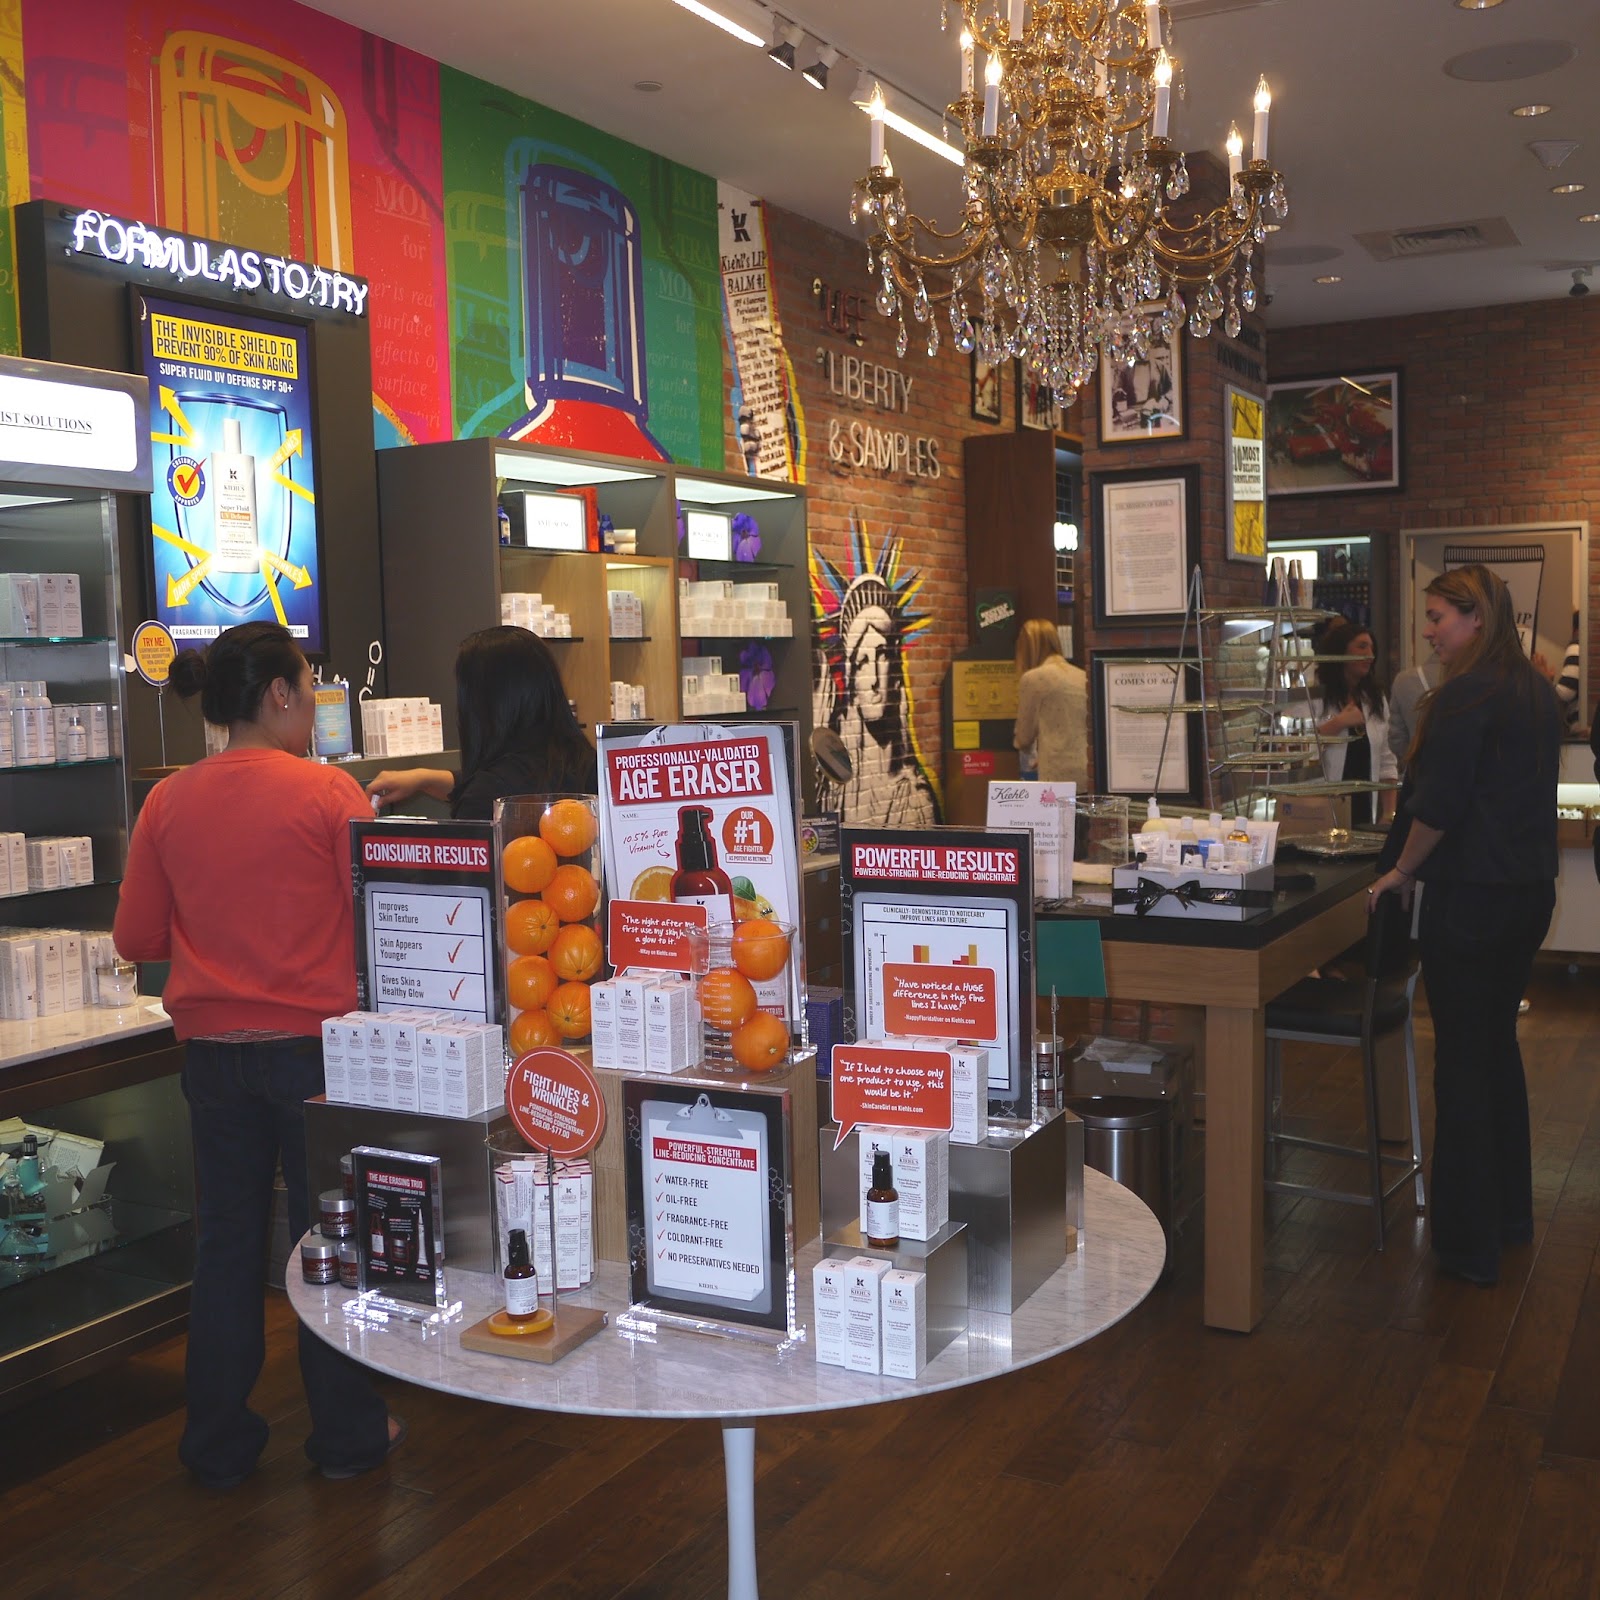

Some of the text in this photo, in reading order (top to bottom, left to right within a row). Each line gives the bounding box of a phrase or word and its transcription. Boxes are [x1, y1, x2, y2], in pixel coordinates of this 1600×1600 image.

[73, 210, 368, 315] FORMULAS TO TRY
[722, 251, 767, 271] Kiehl's LIP
[728, 274, 766, 294] BALM #1
[156, 320, 292, 357] THE INVISIBLE SHIELD TO
[157, 338, 294, 373] PREVENT 90% OF SKIN AGING
[160, 363, 293, 393] SUPER FLUID UV DEFENSE SPF 50+
[830, 351, 913, 413] LIBERTY
[24, 414, 92, 431] SOLUTIONS
[830, 419, 941, 479] & SAMPLES
[1242, 447, 1260, 462] MOST
[173, 583, 191, 602] DARK
[143, 637, 165, 647] TRY ME!
[1115, 678, 1145, 686] COMES
[616, 745, 759, 769] PROFESSIONALLY-VALIDATED
[619, 759, 762, 800] AGE ERASER
[991, 787, 1029, 800] Kiehl's
[741, 811, 753, 819] OUR
[734, 821, 760, 844] #1
[656, 839, 664, 847] C
[365, 843, 487, 866] CONSUMER RESULTS
[855, 847, 1016, 873] POWERFUL RESULTS
[855, 868, 1016, 882] POWERFUL-STRENGTH LINE-REDUCING CONCENTRATE
[379, 901, 409, 913] Improves
[912, 908, 948, 916] DEMONSTRATED
[957, 910, 985, 918] NOTICEABLY
[379, 913, 419, 924] Skin Texture
[641, 917, 659, 927] night
[661, 919, 683, 927] after
[622, 925, 639, 933] first
[654, 928, 663, 937] my
[380, 938, 423, 951] Skin Appears
[642, 936, 656, 945] glow
[380, 949, 407, 961] Younger
[382, 975, 399, 986] Gives
[401, 976, 414, 987] Skin
[921, 981, 952, 990] noticed
[963, 983, 984, 992] HUGE
[382, 986, 424, 999] Healthy Glow
[893, 990, 939, 999] difference
[950, 993, 966, 1001] the
[969, 994, 985, 1002] fine
[911, 1001, 928, 1009] lines
[857, 1063, 862, 1072] I
[864, 1064, 881, 1073] had
[884, 1066, 893, 1074] to
[896, 1067, 925, 1076] choose
[927, 1069, 944, 1080] only
[523, 1069, 589, 1107] FIGHT LINES &
[840, 1075, 944, 1089] one product to use, this
[532, 1085, 578, 1115] WRINKLES
[864, 1088, 887, 1097] would
[890, 1089, 901, 1098] be
[529, 1102, 576, 1126] POWERFUL-STRENGTH
[898, 1105, 923, 1113] Kiehls.com
[520, 1105, 584, 1136] LINE-REDUCING CONCENTRATE
[655, 1148, 755, 1169] LINE-REDUCING CONCENTRATE
[668, 1142, 741, 1159] POWERFUL-STRENGTH
[369, 1172, 422, 1189] THE AGE ERASING TRIO
[665, 1175, 709, 1189] WATER-FREE
[665, 1194, 698, 1207] OIL-FREE
[666, 1213, 729, 1231] FRAGRANCE-FREE
[667, 1232, 723, 1248] COLORANT-FREE
[668, 1252, 760, 1274] NO PRESERVATIVES NEEDED
